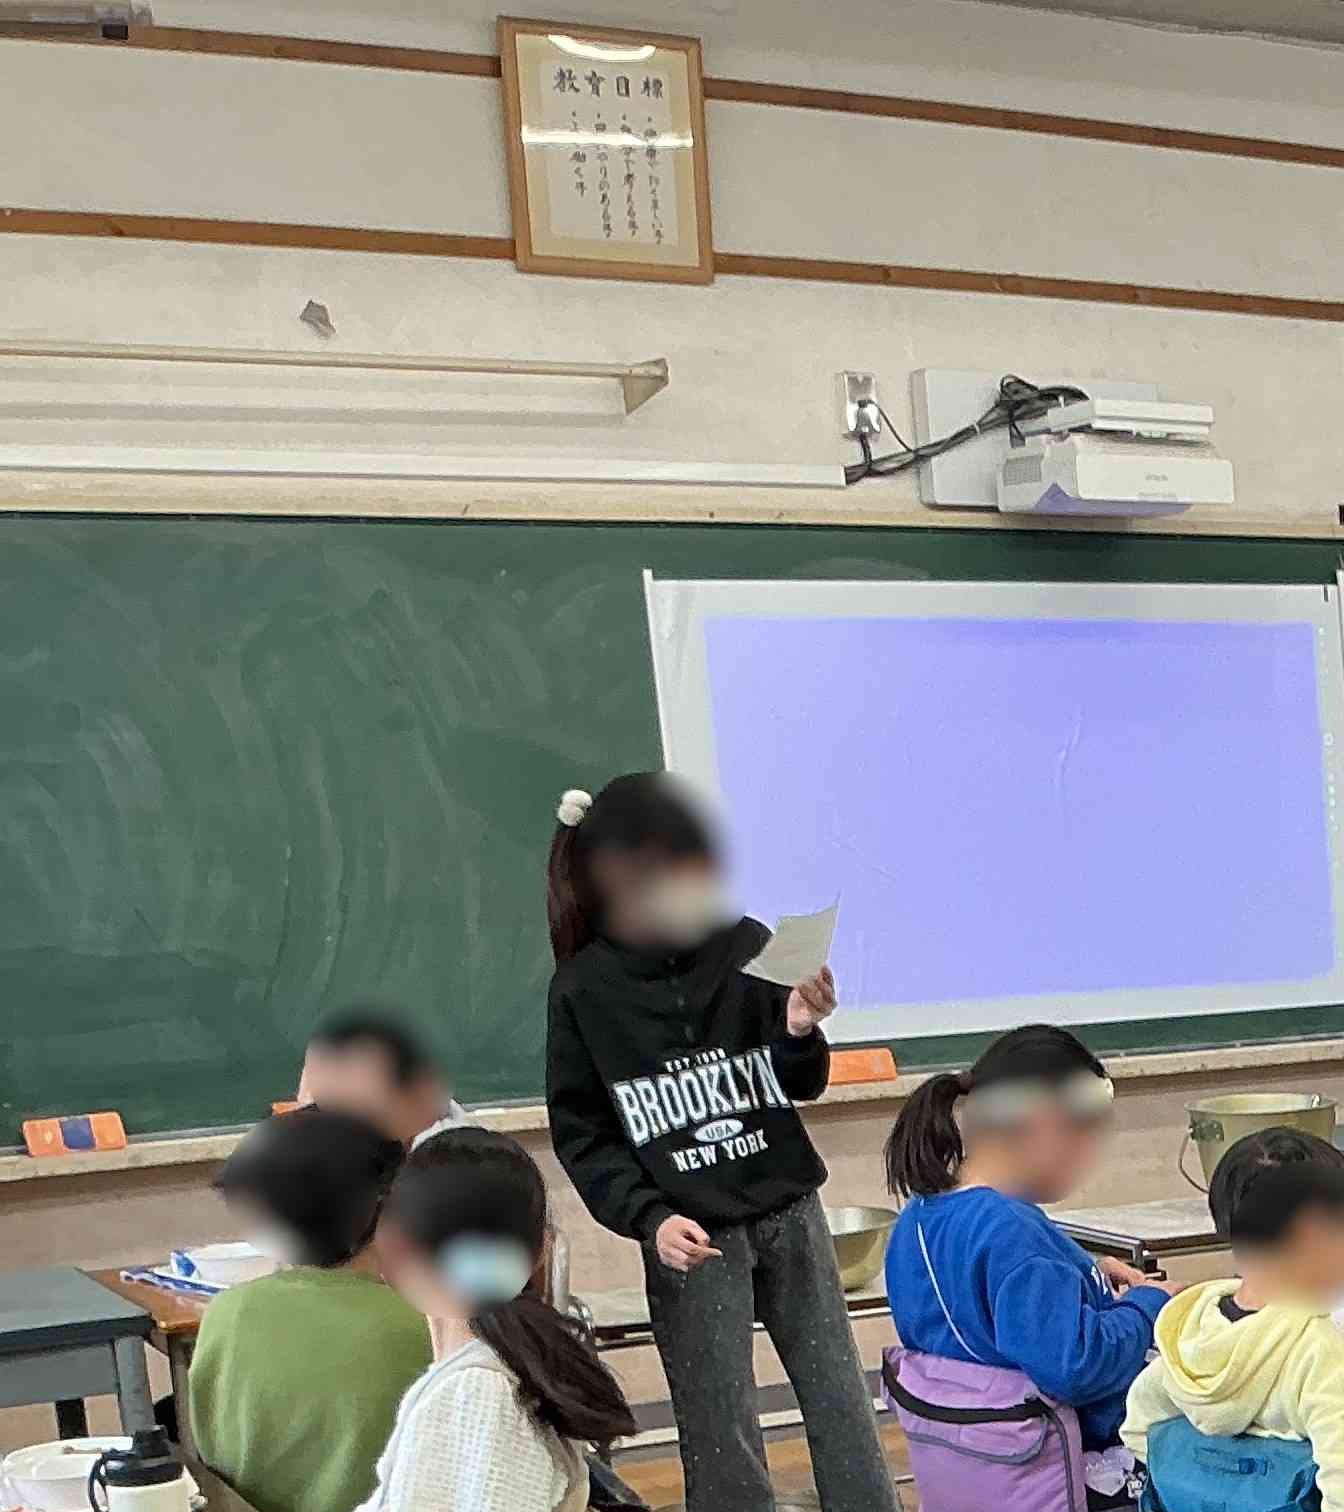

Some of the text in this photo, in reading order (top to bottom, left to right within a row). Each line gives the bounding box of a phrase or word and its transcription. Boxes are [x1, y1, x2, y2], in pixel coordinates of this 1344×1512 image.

[553, 66, 664, 99] 教育目標
[612, 1044, 794, 1148] BROOKLYN
[671, 1128, 769, 1173] NEW YORK
